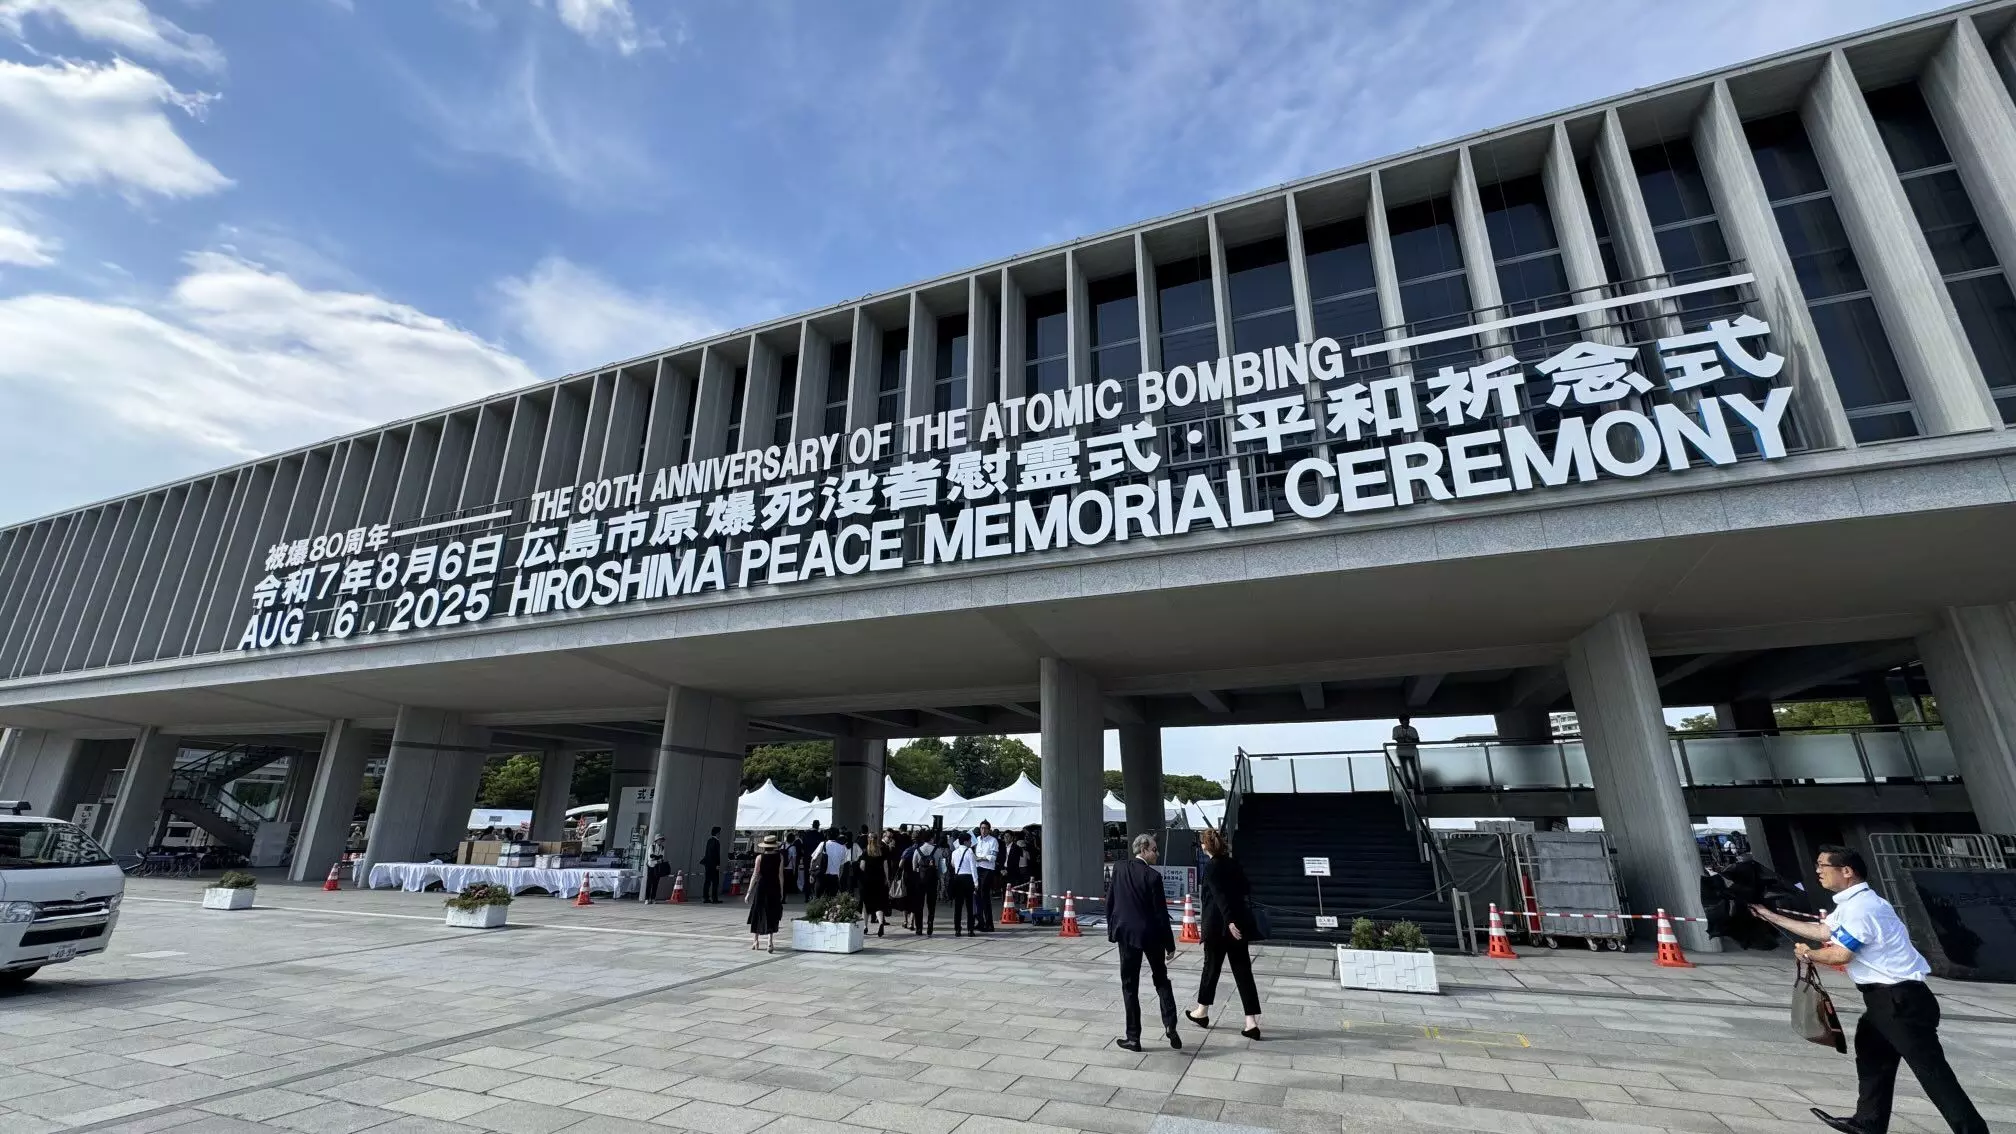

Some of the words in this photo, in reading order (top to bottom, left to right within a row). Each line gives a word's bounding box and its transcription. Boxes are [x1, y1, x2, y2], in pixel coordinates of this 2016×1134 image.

[531, 485, 576, 524] THE
[577, 472, 646, 515] 80TH
[649, 432, 840, 503] ANNIVERSARY
[848, 421, 893, 465] OF
[903, 407, 968, 455] THE
[979, 378, 1124, 443] ATOMIC
[1137, 336, 1346, 414] BOMBING
[508, 545, 726, 617] HIROSHIMA
[738, 517, 906, 589] PEACE
[923, 467, 1275, 566] MEMORIAL
[1284, 385, 1794, 519] CEREMONY
[252, 533, 505, 610] 令和7年8月6日
[264, 523, 391, 572] 被爆80周年
[388, 579, 494, 633] 2025
